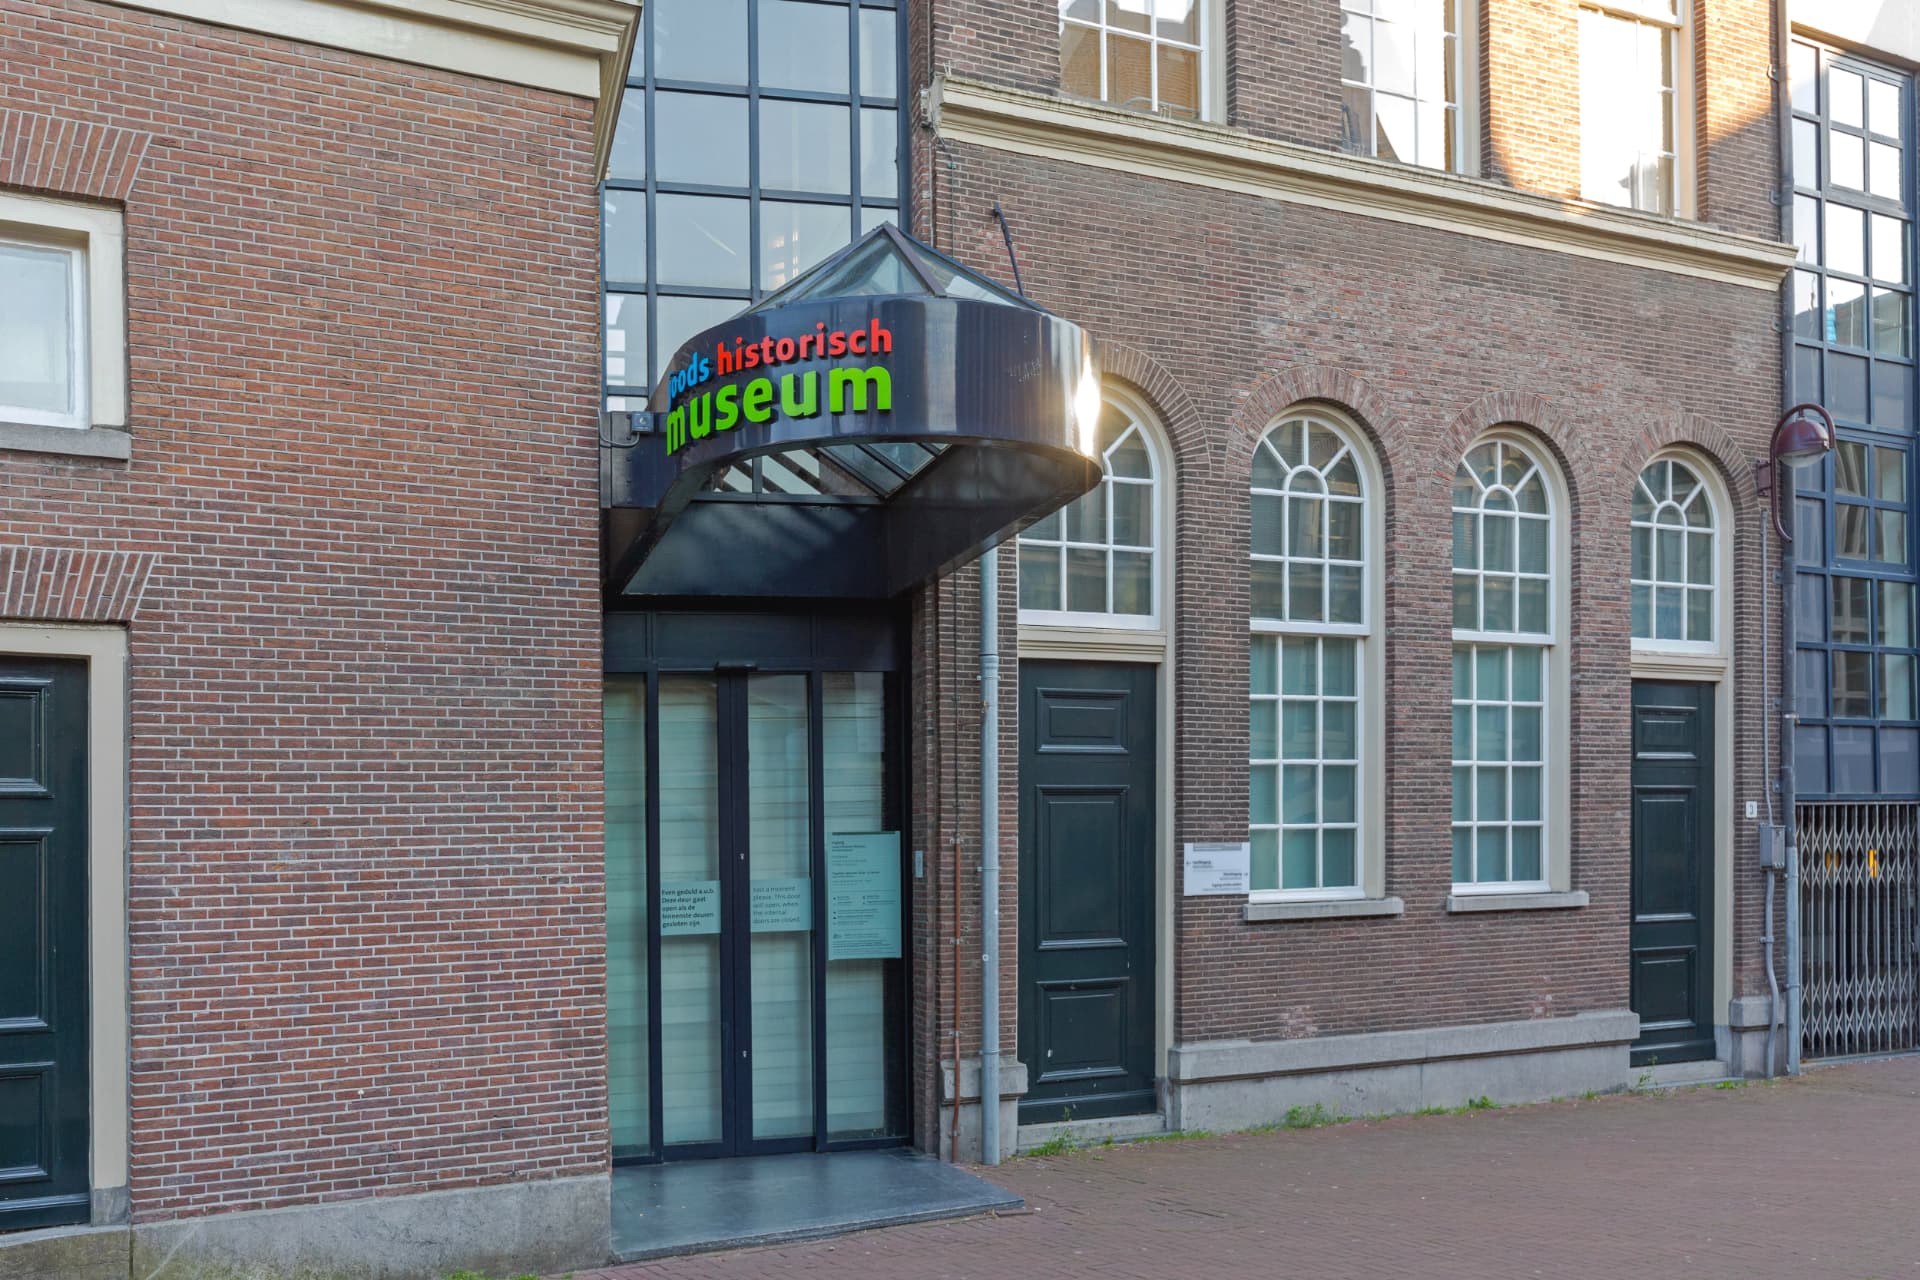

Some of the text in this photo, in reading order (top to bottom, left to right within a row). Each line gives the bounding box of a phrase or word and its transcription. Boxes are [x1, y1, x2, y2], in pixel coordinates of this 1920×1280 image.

[667, 318, 892, 412] joods historisch
[667, 366, 891, 456] museum
